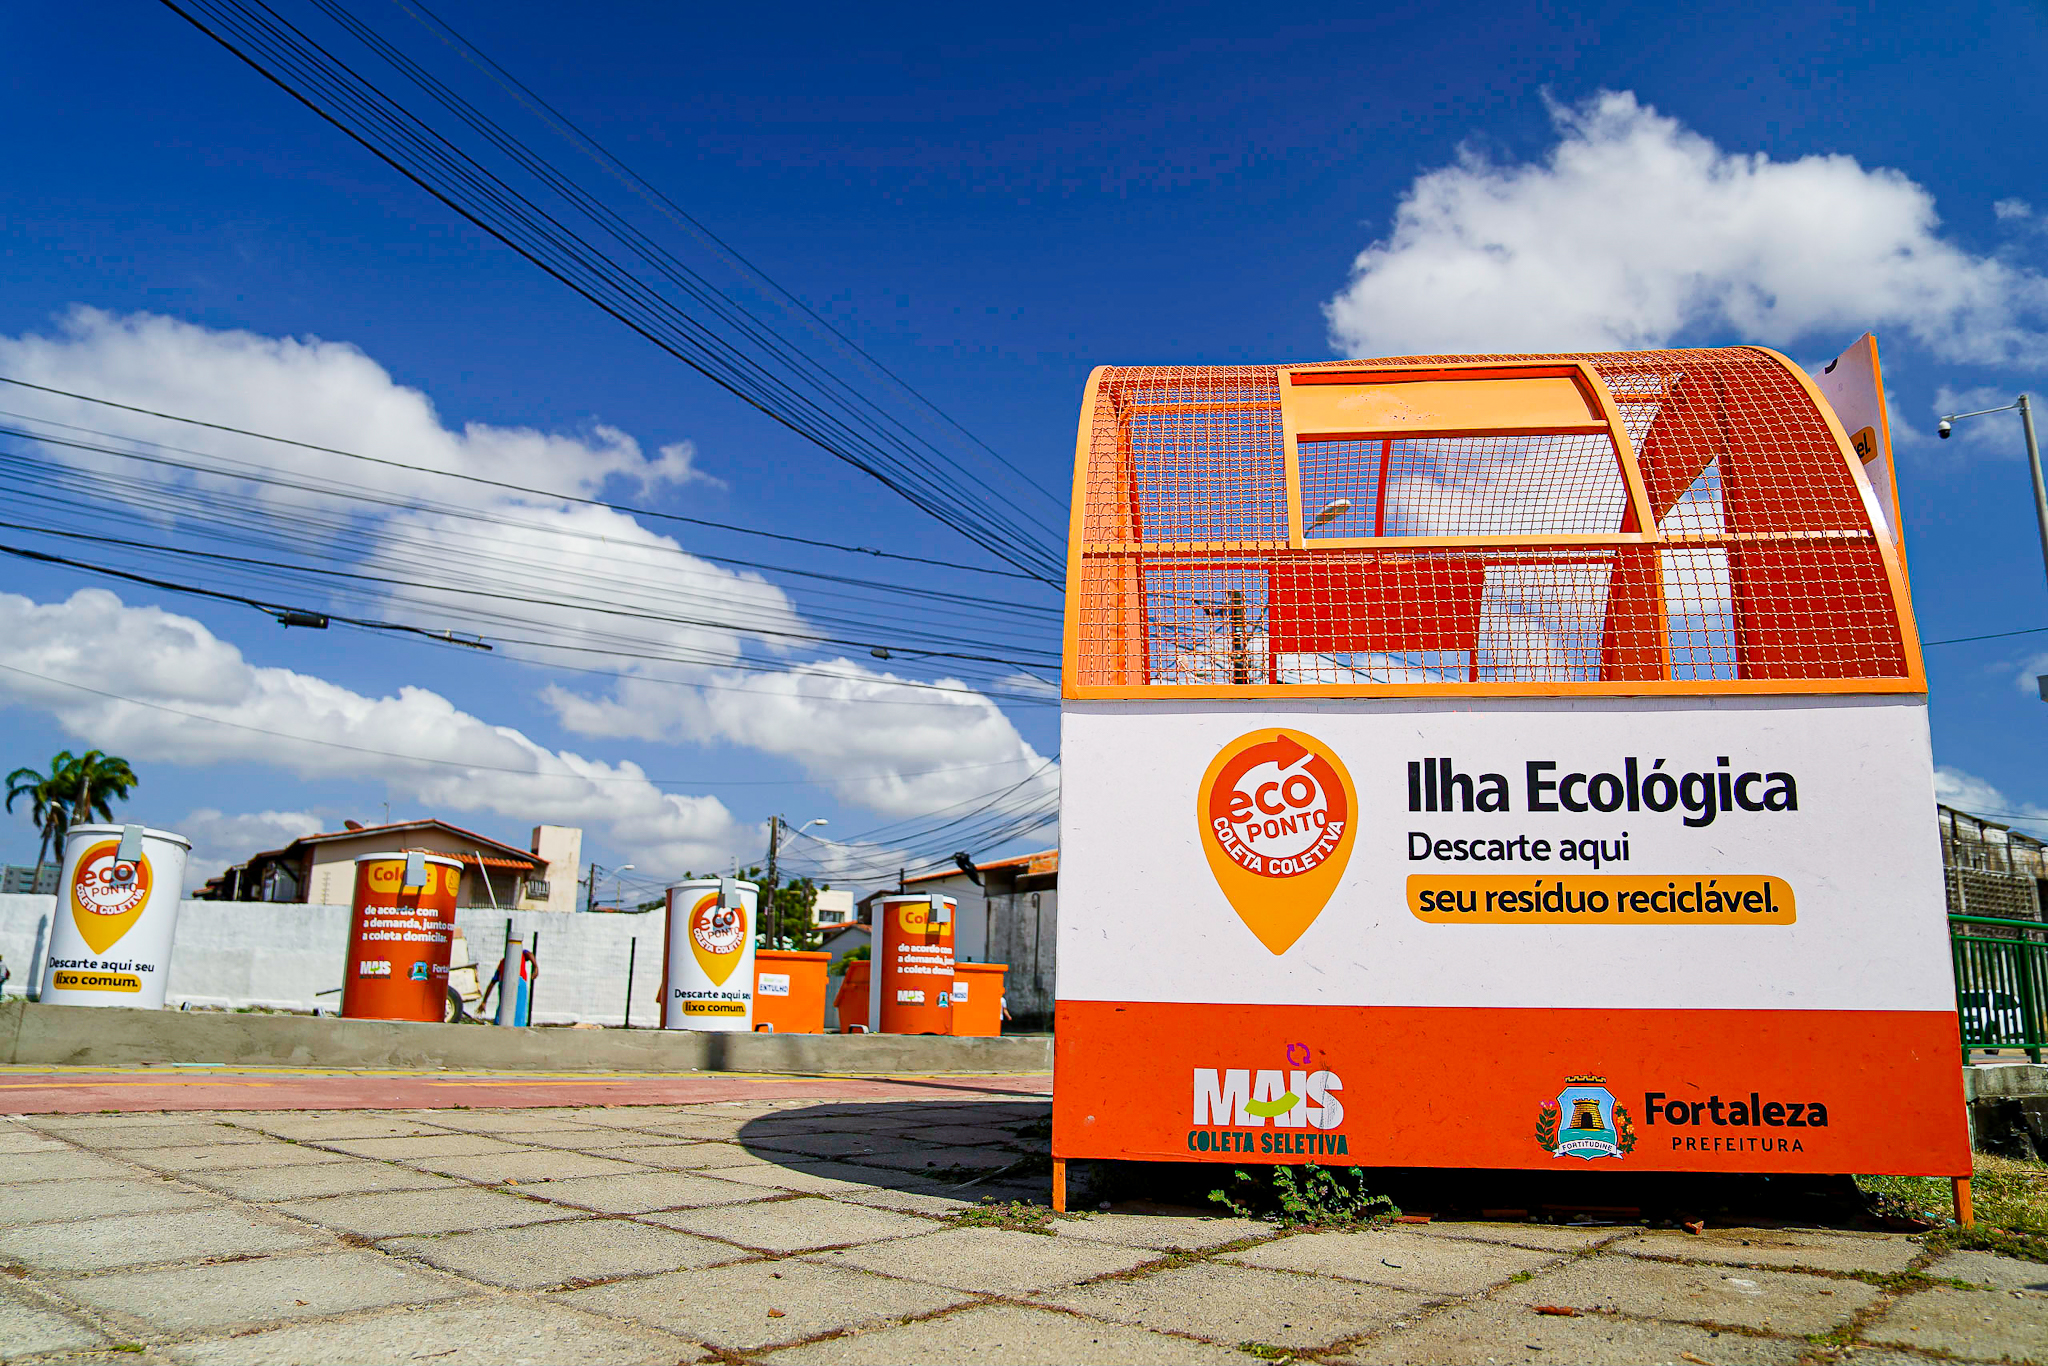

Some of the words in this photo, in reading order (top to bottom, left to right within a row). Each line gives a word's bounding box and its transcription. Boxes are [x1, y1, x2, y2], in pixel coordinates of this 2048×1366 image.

[1229, 774, 1316, 824] eco
[1407, 757, 1510, 812] Ilha
[1526, 756, 1799, 828] Ecológica
[1246, 809, 1328, 843] PONTO
[1213, 816, 1262, 873] COLETA
[1268, 820, 1345, 875] COLETIVA
[1407, 831, 1551, 861] Descarte
[1559, 831, 1630, 870] aqui
[83, 864, 135, 887] eco
[374, 867, 431, 883] Col:
[91, 882, 138, 897] PONTO
[1419, 888, 1477, 914] seu
[1485, 879, 1610, 914] resíduo
[1617, 879, 1779, 914] reciclável.
[76, 883, 97, 913] COLETA
[99, 889, 146, 915] COLETIVA
[364, 904, 376, 915] de
[377, 905, 415, 916] acordo
[416, 908, 439, 917] com
[363, 919, 369, 928] a
[370, 917, 423, 930] demanda,
[422, 919, 446, 931] junto
[700, 911, 736, 931] eco
[362, 932, 368, 941] a
[369, 930, 402, 941] coleta
[693, 928, 714, 953] COLETA
[708, 927, 740, 939] PONTO
[897, 943, 910, 952] de
[910, 944, 940, 953] acordo
[49, 957, 98, 969] Descarte
[101, 959, 133, 973] aqui
[135, 962, 155, 972] seu
[897, 955, 903, 963] a
[903, 964, 932, 974] coleta
[56, 972, 78, 985] lixo
[81, 975, 138, 988] comum.
[674, 988, 719, 998] Descarte
[721, 989, 741, 1002] aqui
[685, 1001, 705, 1011] lixo
[1193, 1068, 1344, 1130] MAIS
[1644, 1092, 1829, 1128] Fortaleza
[1187, 1130, 1255, 1153] COLETA
[1260, 1132, 1349, 1156] SELETIVA
[1561, 1140, 1613, 1152] FORTITUDINE
[1672, 1136, 1804, 1153] PREFEITURA
